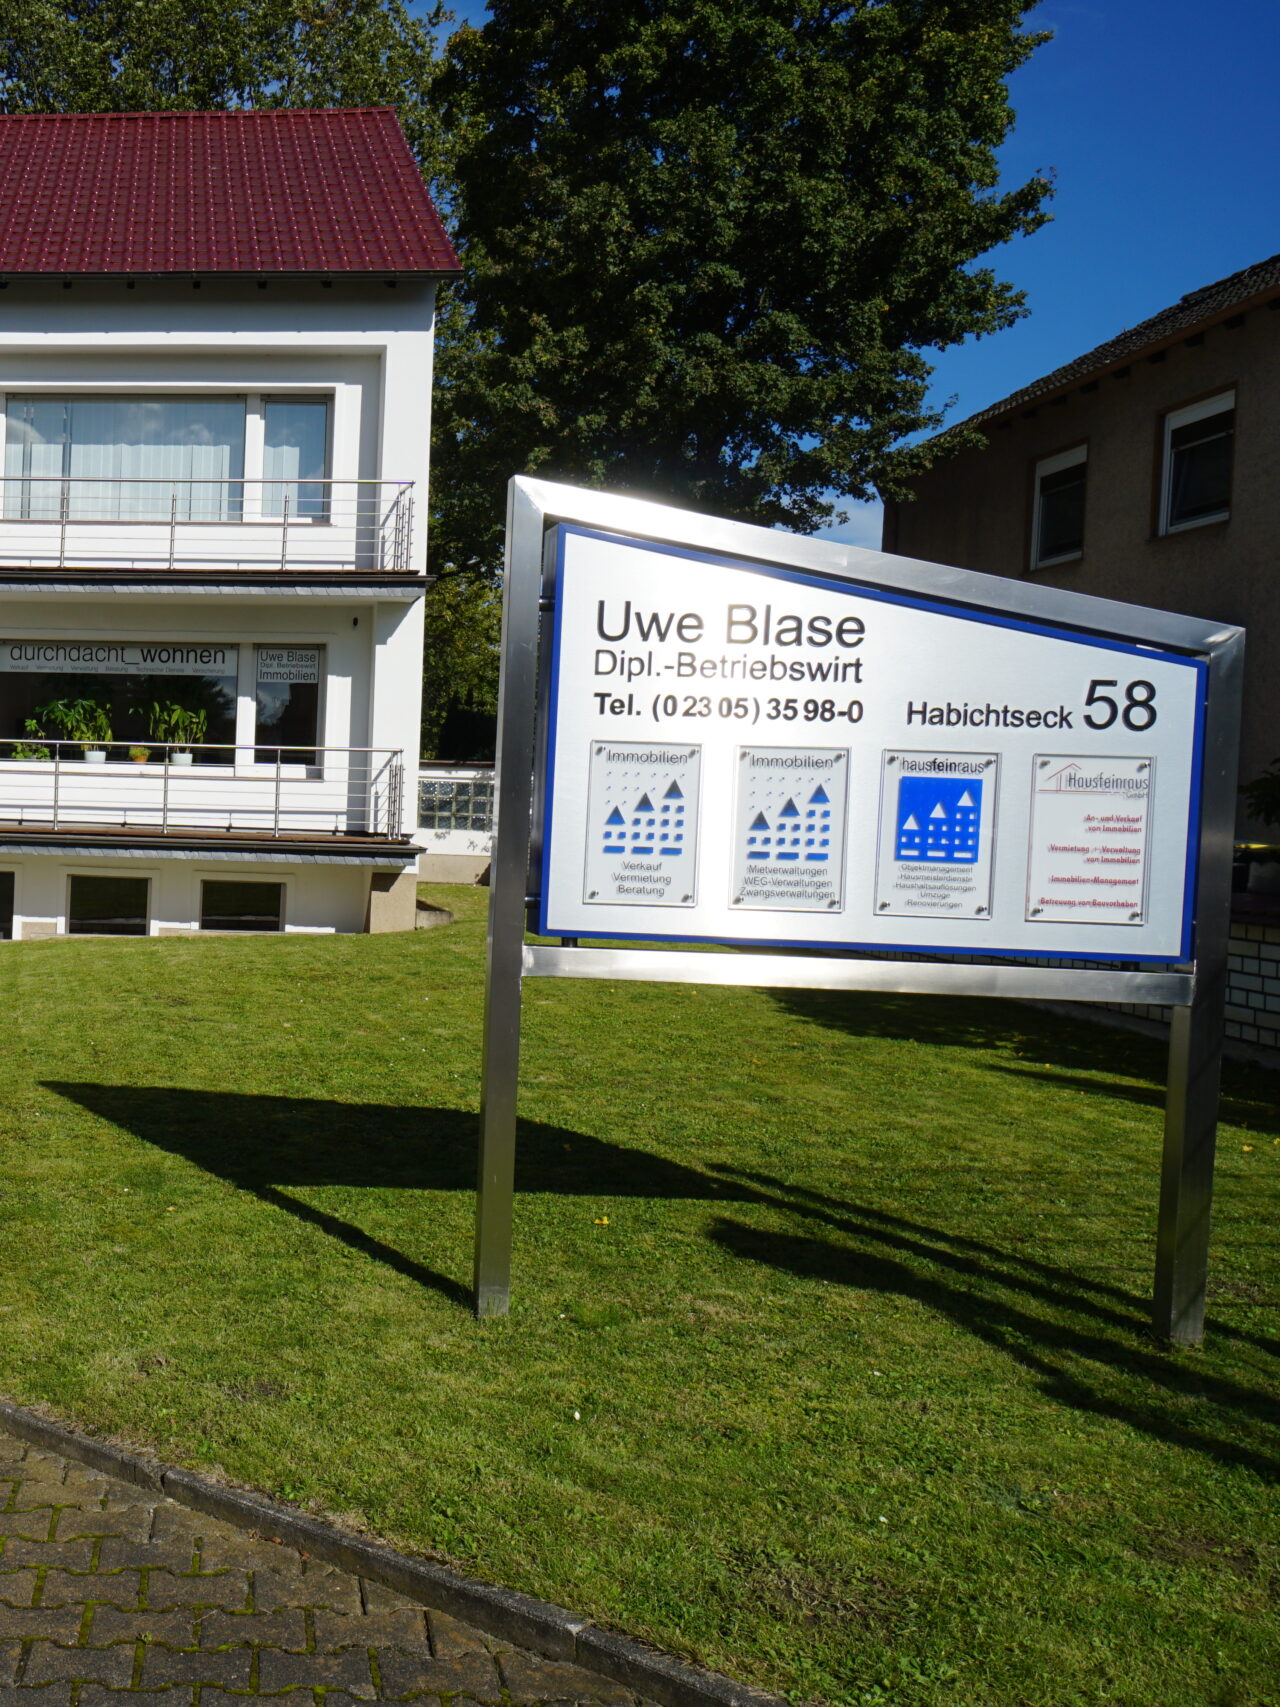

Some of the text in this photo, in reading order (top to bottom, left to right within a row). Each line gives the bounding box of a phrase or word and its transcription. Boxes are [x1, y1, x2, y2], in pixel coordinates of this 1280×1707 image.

[596, 600, 866, 648] Uwe Blase
[260, 650, 316, 662] Uwe Blase
[594, 649, 864, 683] Dipl.-Betriebswirt
[260, 670, 316, 681] Immobilien
[593, 692, 642, 716] Tel.
[907, 679, 1158, 732] Habichtseck 58
[606, 749, 688, 765] Immobilien
[750, 754, 834, 769] Immobilien
[901, 757, 985, 773] hausfeinraus
[1068, 772, 1149, 790] Hausfeinraus
[1115, 815, 1143, 824] Verkauf
[1102, 825, 1142, 834] Immobilien
[1049, 844, 1090, 854] Vermietung
[1101, 846, 1141, 857] Verwaltung
[622, 861, 663, 871] Verkauf
[1100, 856, 1140, 865] Immobilien
[747, 864, 828, 877] Mietverwaltungen
[613, 872, 672, 885] Vermietung
[744, 876, 833, 890] WEG-Verwaltungen
[1050, 875, 1139, 887] Immobilien-Management
[617, 885, 665, 897] Beratung
[740, 887, 836, 900] Zwangsverwaltungen
[905, 899, 963, 909] Renovierungen
[1039, 897, 1077, 908] Betreuung
